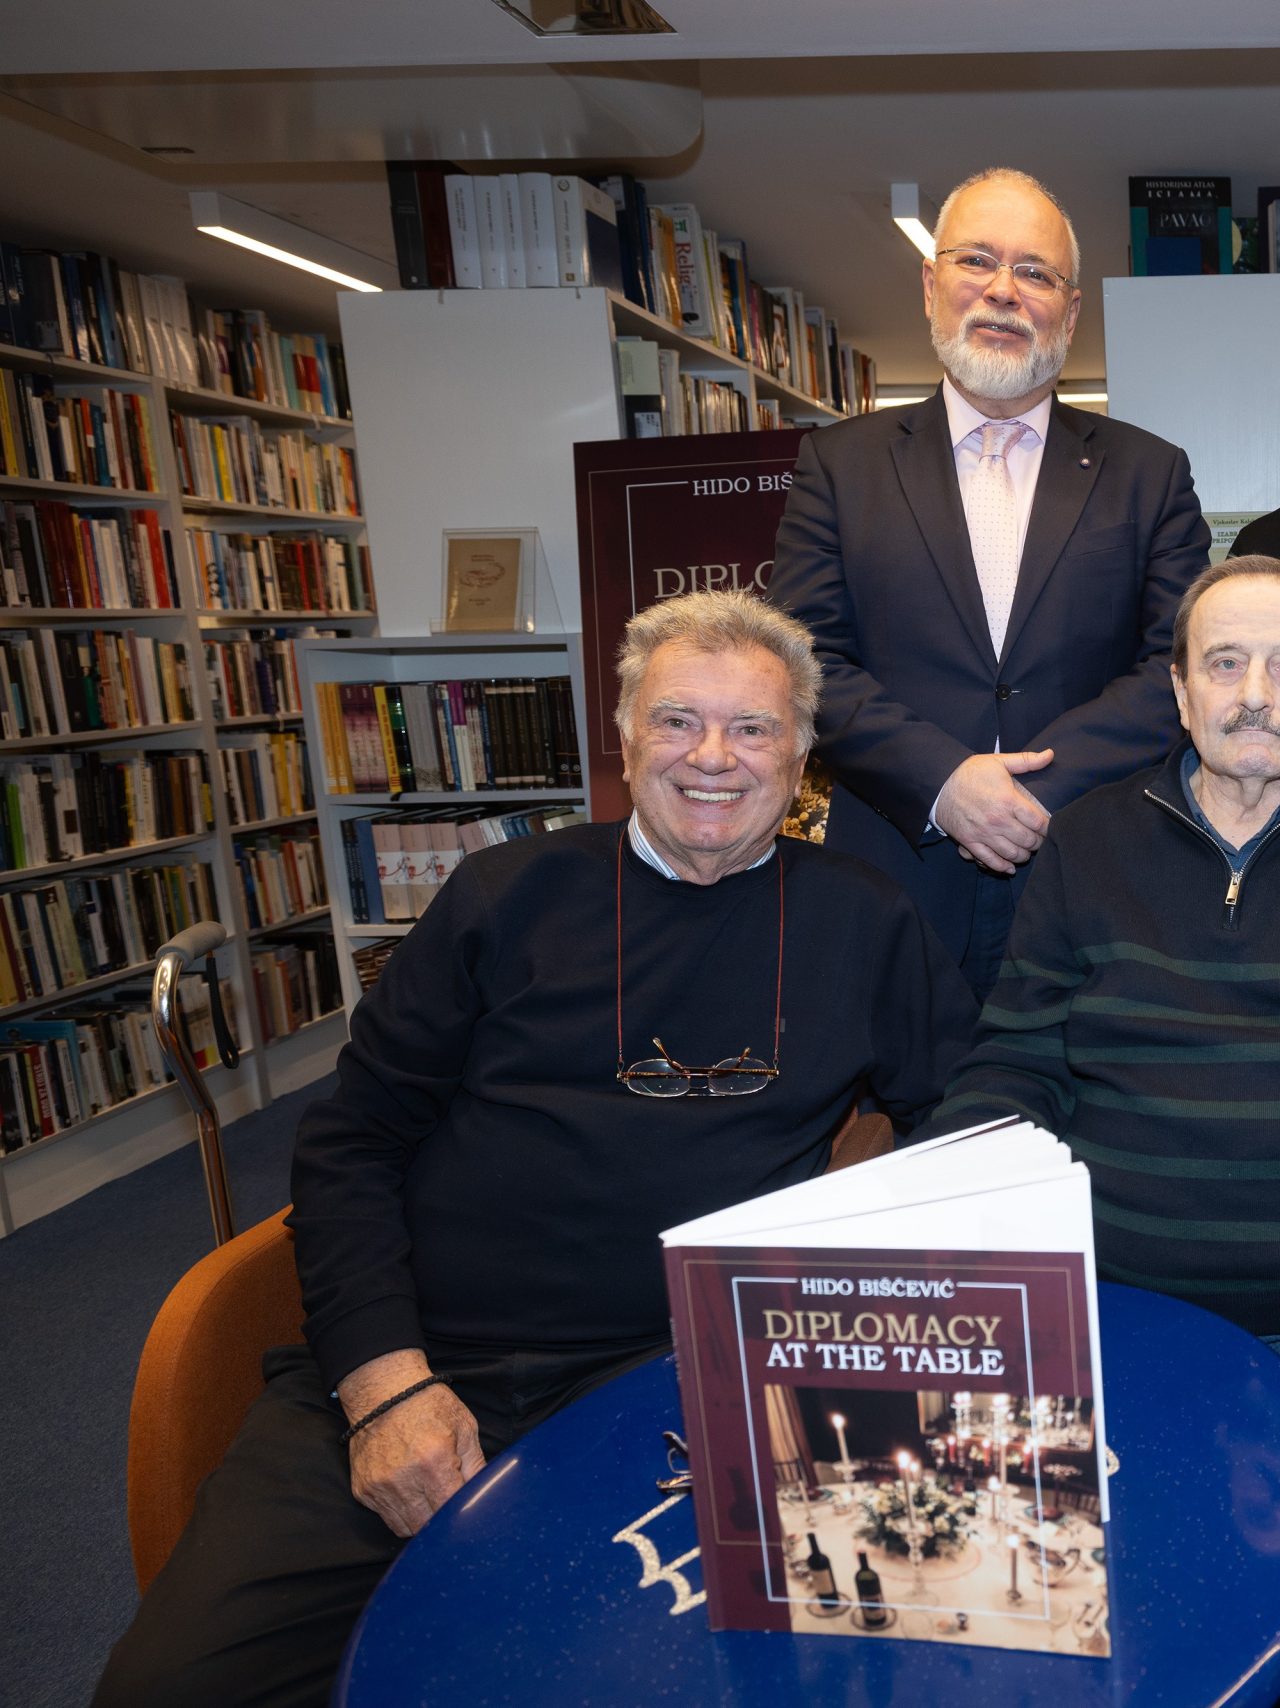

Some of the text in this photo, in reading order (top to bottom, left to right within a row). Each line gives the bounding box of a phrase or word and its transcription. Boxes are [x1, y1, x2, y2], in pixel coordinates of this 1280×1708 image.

[1193, 181, 1216, 189] ATLAS
[692, 477, 750, 496] HIDO
[801, 1276, 956, 1298] HIDO BIŠČEVIĆ
[762, 1309, 1002, 1346] DIPLOMACY
[766, 1342, 1005, 1375] AT THE TABLE
